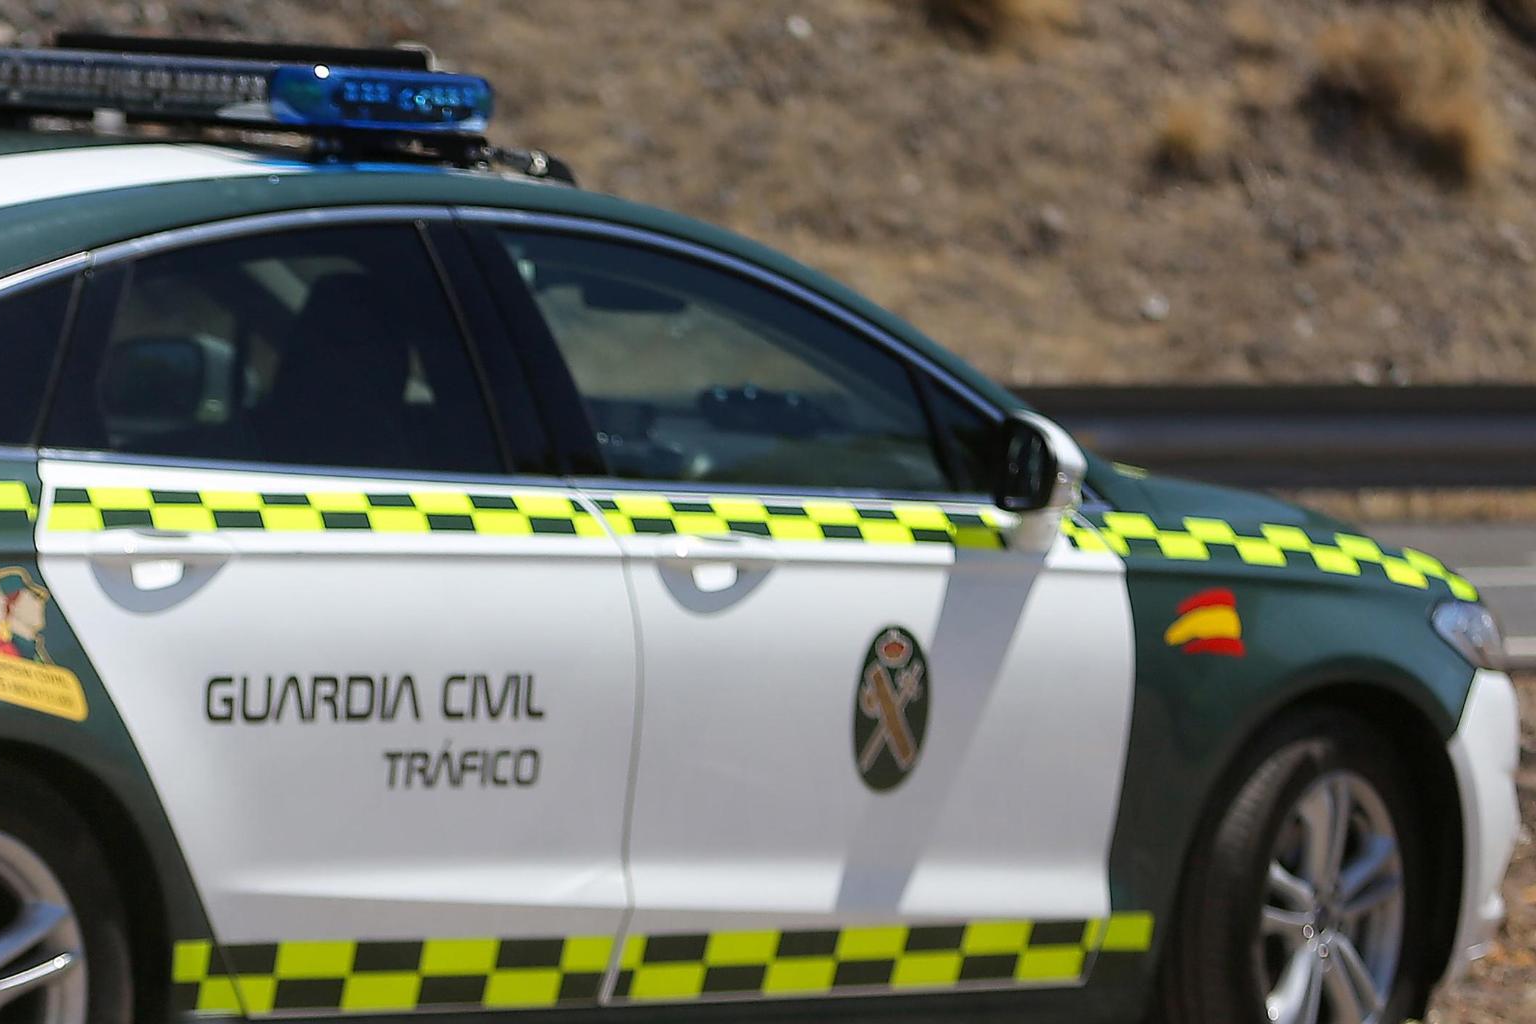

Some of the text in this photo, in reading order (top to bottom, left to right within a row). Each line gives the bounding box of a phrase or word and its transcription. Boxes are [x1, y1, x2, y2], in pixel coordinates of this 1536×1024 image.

[206, 673, 546, 723] GUARDIA CIVIL
[383, 738, 541, 790] TRÁFICO
